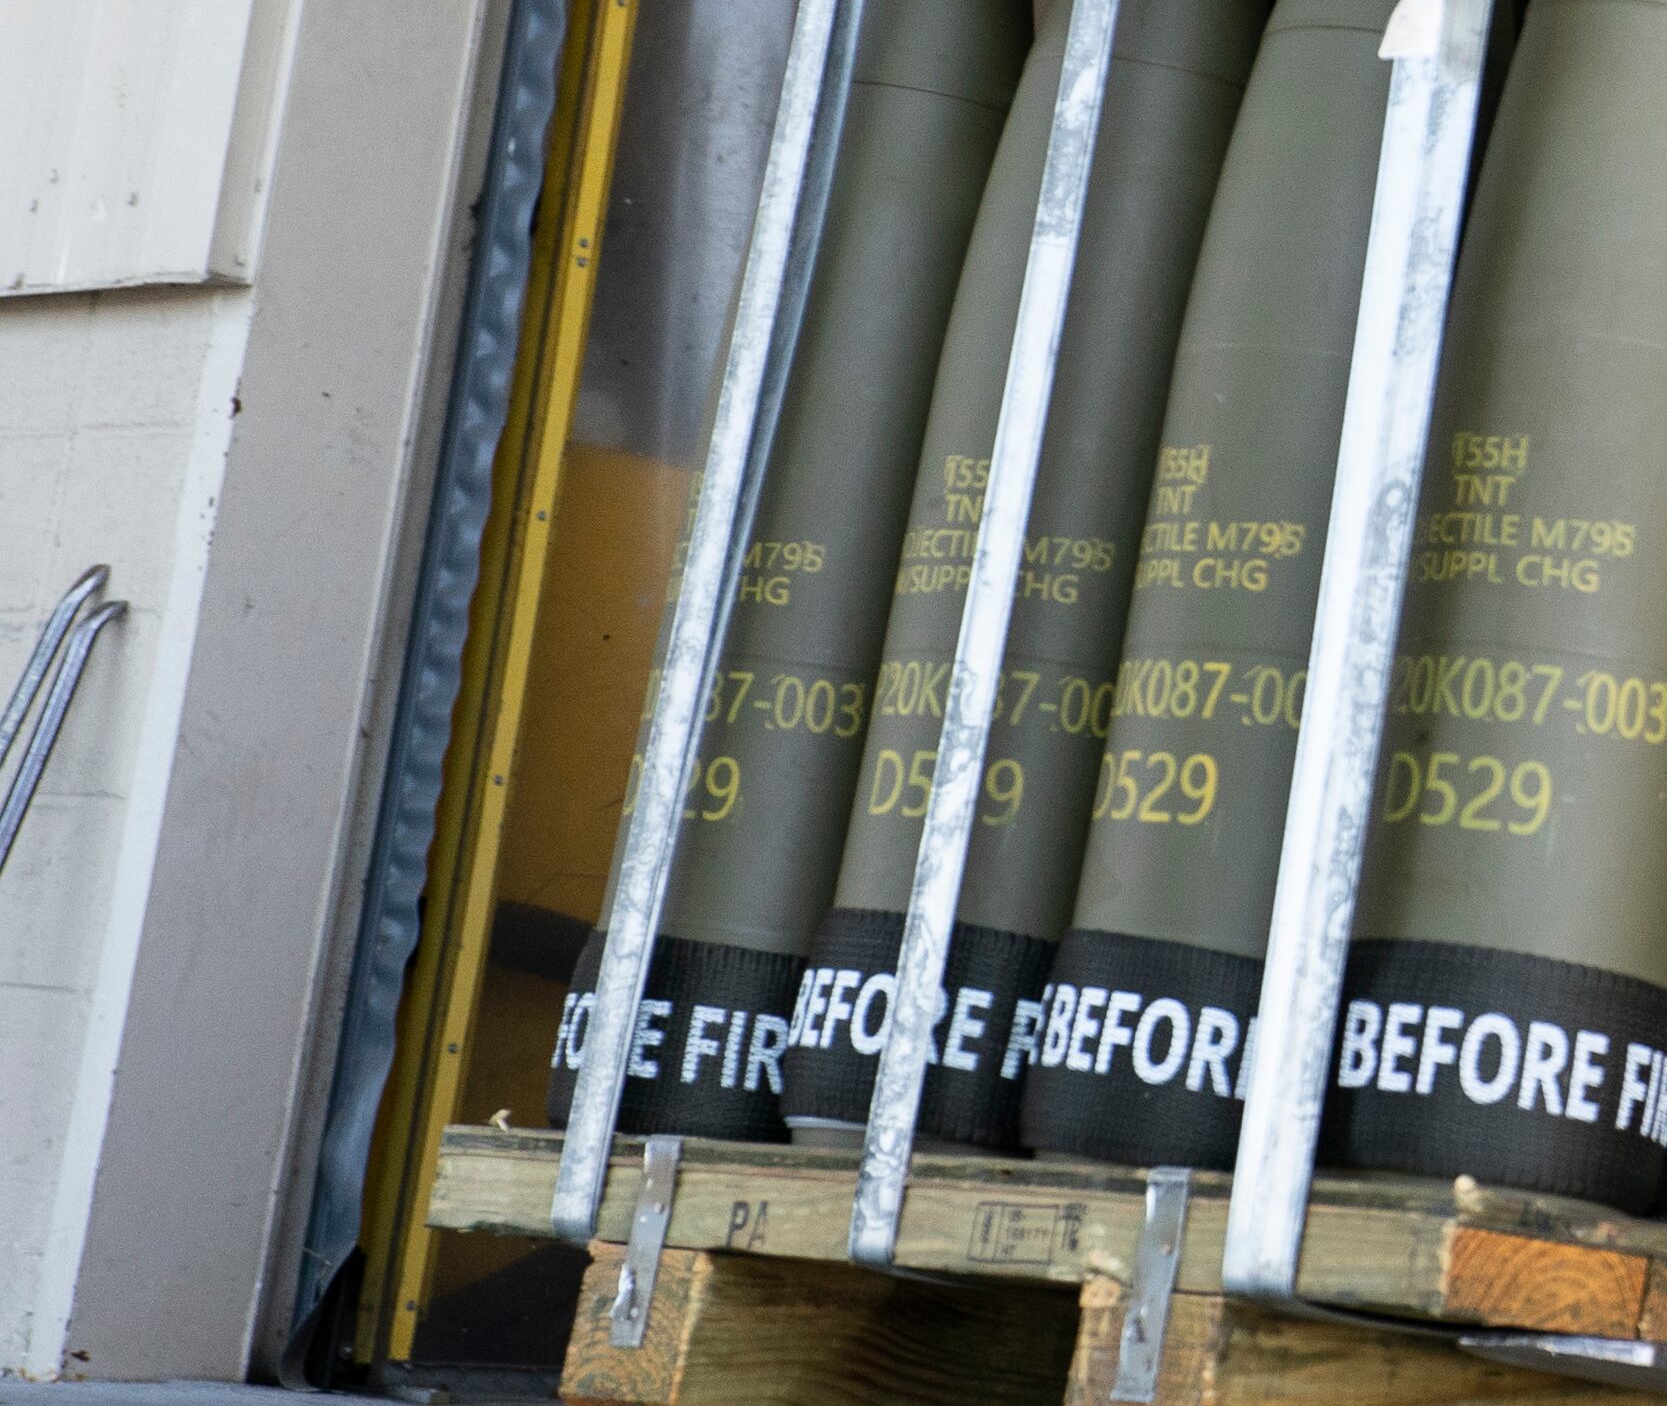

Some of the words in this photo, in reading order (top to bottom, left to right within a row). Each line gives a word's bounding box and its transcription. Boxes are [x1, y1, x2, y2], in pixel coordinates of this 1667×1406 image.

[944, 453, 989, 489] 155
[1455, 474, 1515, 506] TNT
[945, 493, 980, 524] TN
[1207, 523, 1305, 559] M795
[1531, 517, 1636, 557] M795
[739, 577, 792, 606] HG
[1016, 574, 1079, 603] HG
[1193, 558, 1268, 592] CHG
[1515, 555, 1600, 593] CHG
[868, 748, 1024, 826] D59
[1384, 752, 1553, 835] D529
[1338, 998, 1608, 1123] BEFORE
[728, 1199, 770, 1249] PA
